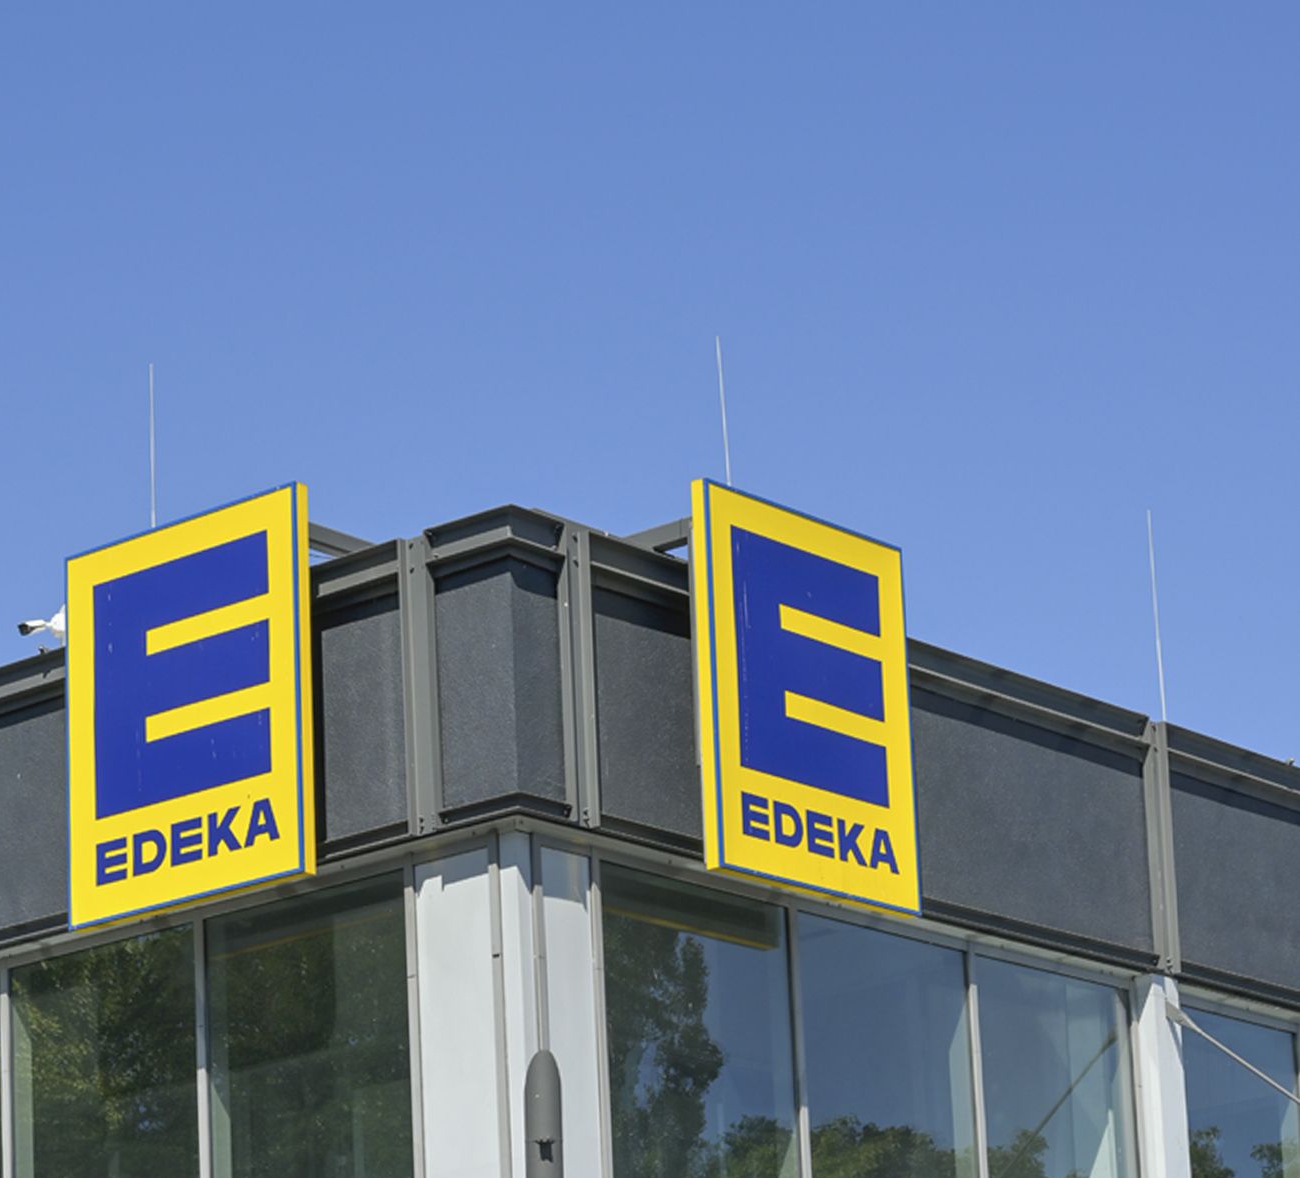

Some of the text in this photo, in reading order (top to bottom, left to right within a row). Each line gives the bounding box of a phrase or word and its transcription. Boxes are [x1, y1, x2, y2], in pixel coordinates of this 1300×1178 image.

[93, 529, 272, 819] E
[730, 525, 890, 808] E
[95, 798, 279, 886] EDEKA
[741, 791, 899, 875] EDEKA
